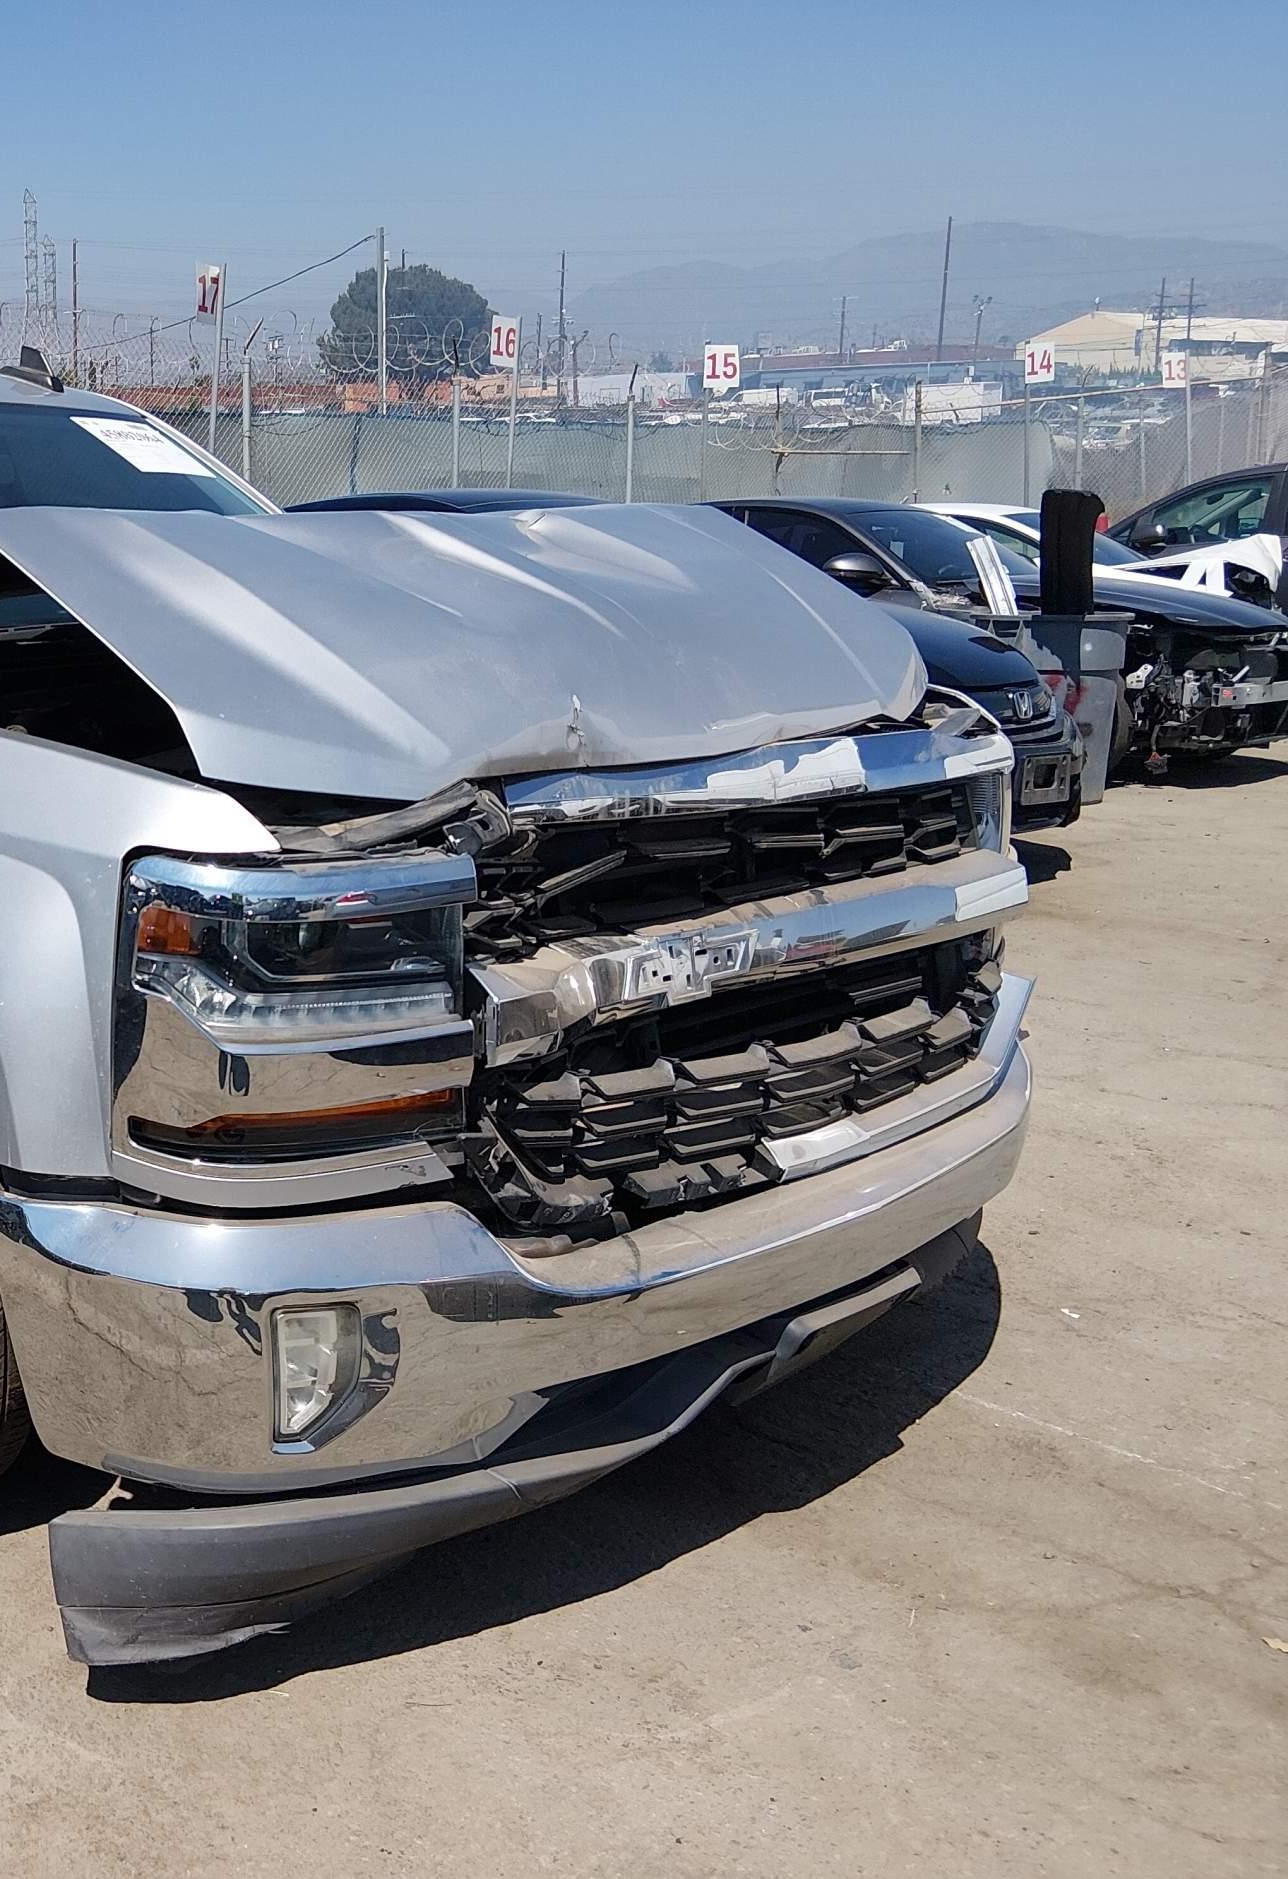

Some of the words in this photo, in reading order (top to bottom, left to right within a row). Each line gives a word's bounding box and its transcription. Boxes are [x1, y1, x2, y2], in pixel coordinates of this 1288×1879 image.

[198, 274, 220, 314] 17
[492, 326, 516, 358] 16
[706, 352, 738, 379] 15
[1027, 350, 1053, 375] 14
[1164, 359, 1188, 380] 13
